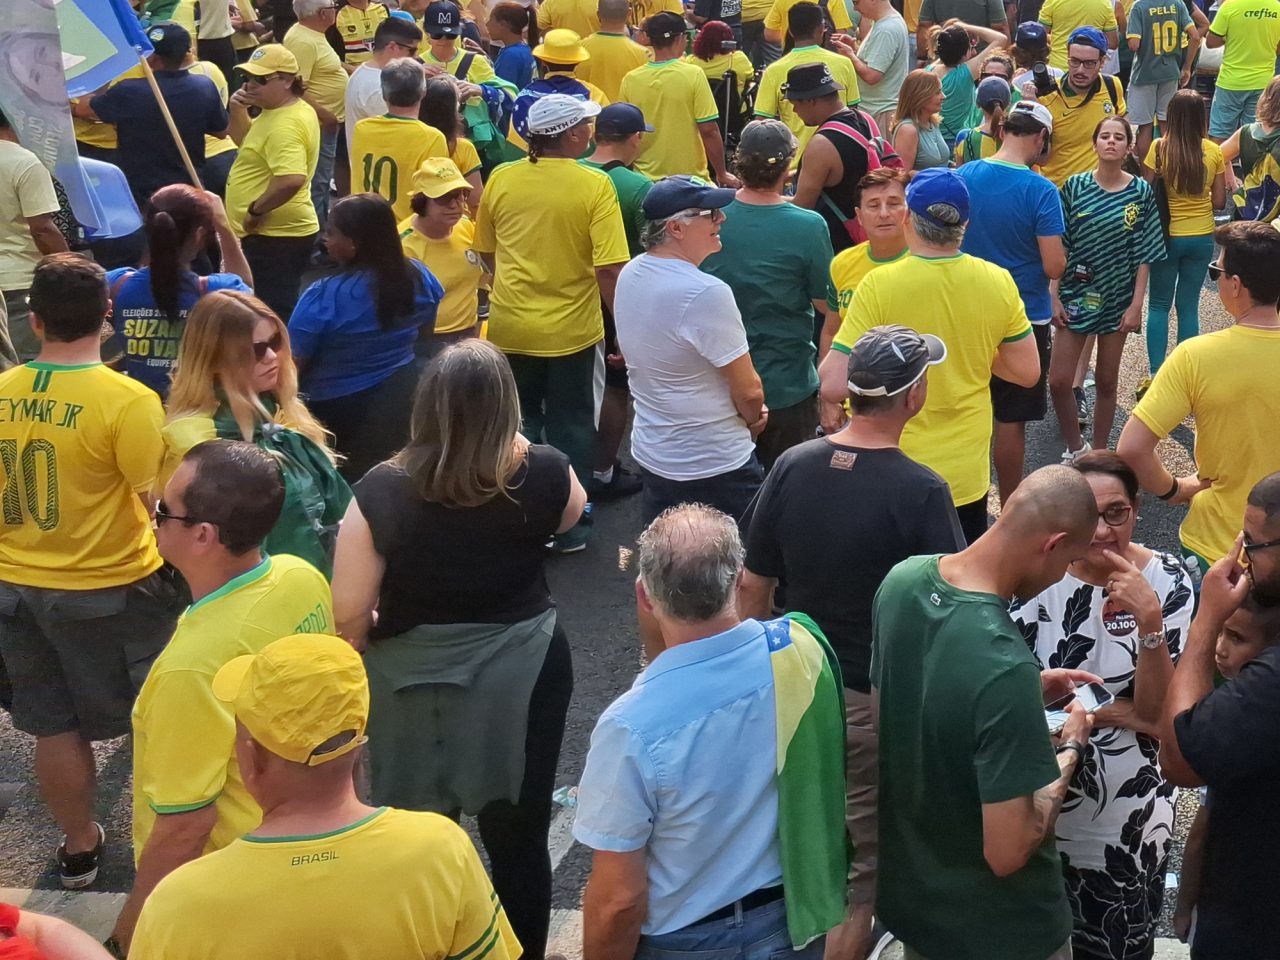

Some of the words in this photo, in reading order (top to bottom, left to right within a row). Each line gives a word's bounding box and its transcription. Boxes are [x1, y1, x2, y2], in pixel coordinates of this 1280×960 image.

[1149, 4, 1177, 16] PELÉ
[1244, 8, 1278, 20] crefisa
[1152, 20, 1178, 55] 10
[363, 153, 398, 207] 10
[127, 338, 150, 356] DO
[56, 402, 84, 429] JR
[0, 438, 60, 532] 10
[1106, 620, 1136, 631] 20.100
[291, 850, 340, 866] BRASIL
